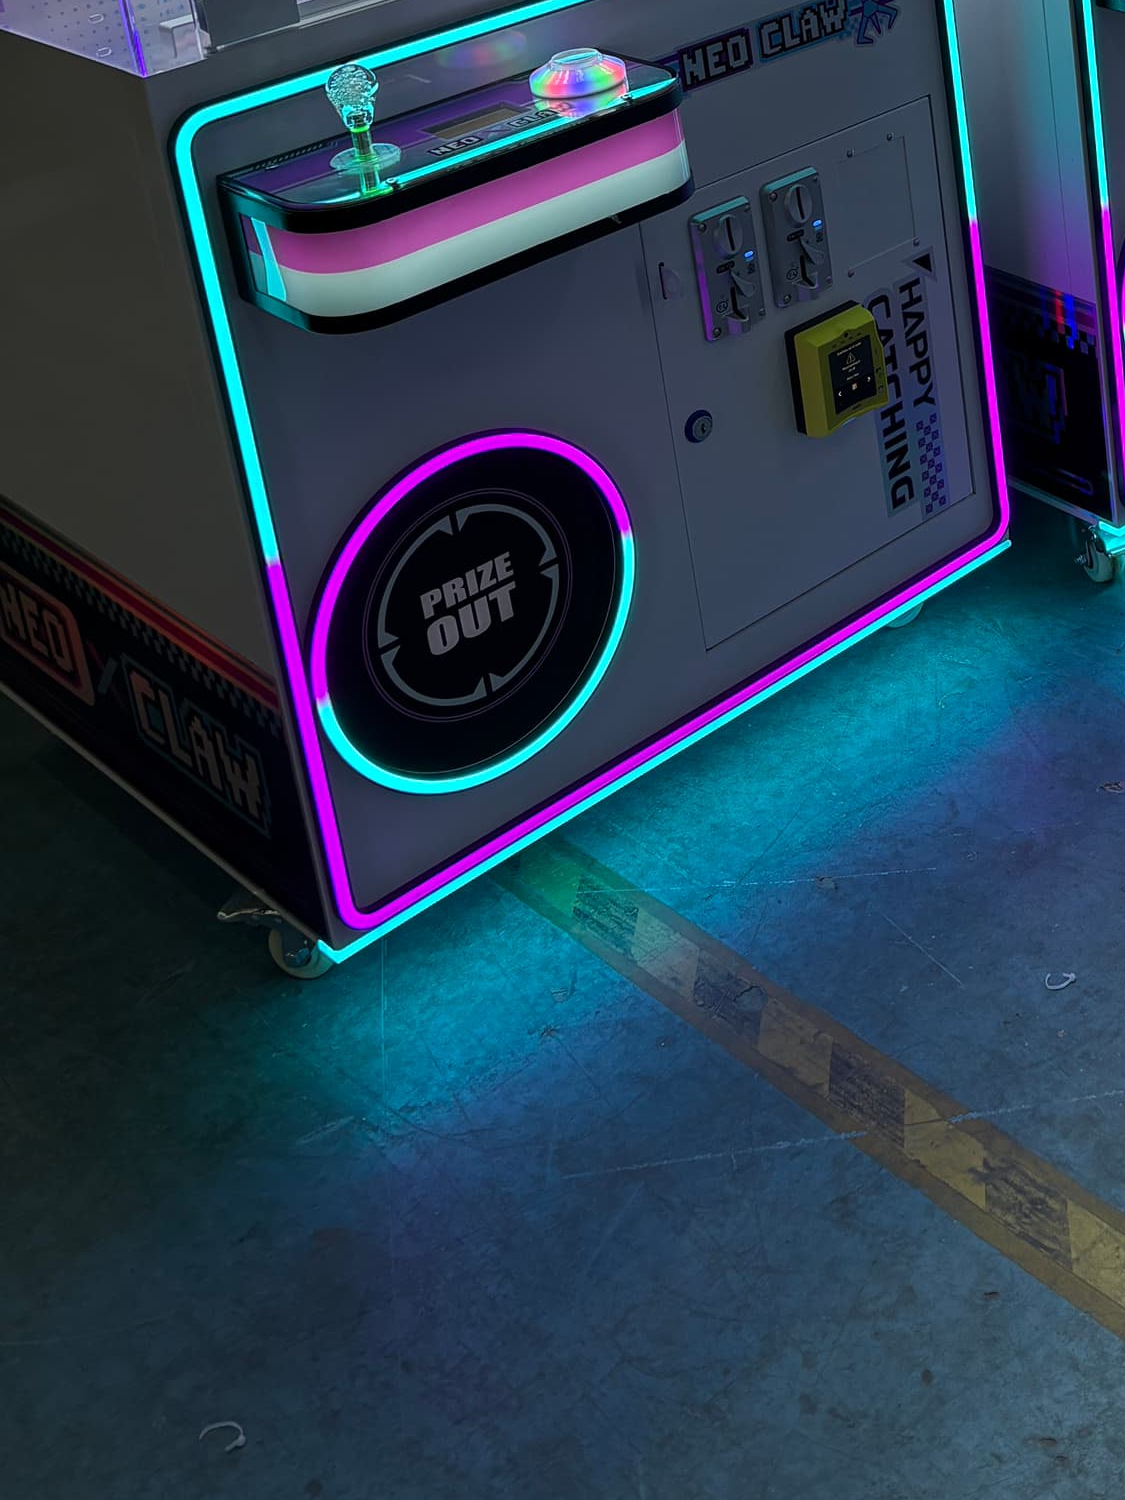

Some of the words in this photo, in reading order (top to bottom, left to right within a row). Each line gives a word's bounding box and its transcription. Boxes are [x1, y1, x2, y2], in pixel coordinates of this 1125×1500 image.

[681, 34, 750, 86] NEO
[429, 135, 483, 156] NEO
[899, 277, 937, 408] HAPPY
[419, 551, 515, 620] PRIZE
[426, 580, 517, 656] OUT
[0, 581, 73, 675] NEO
[128, 668, 263, 822] CLAW
